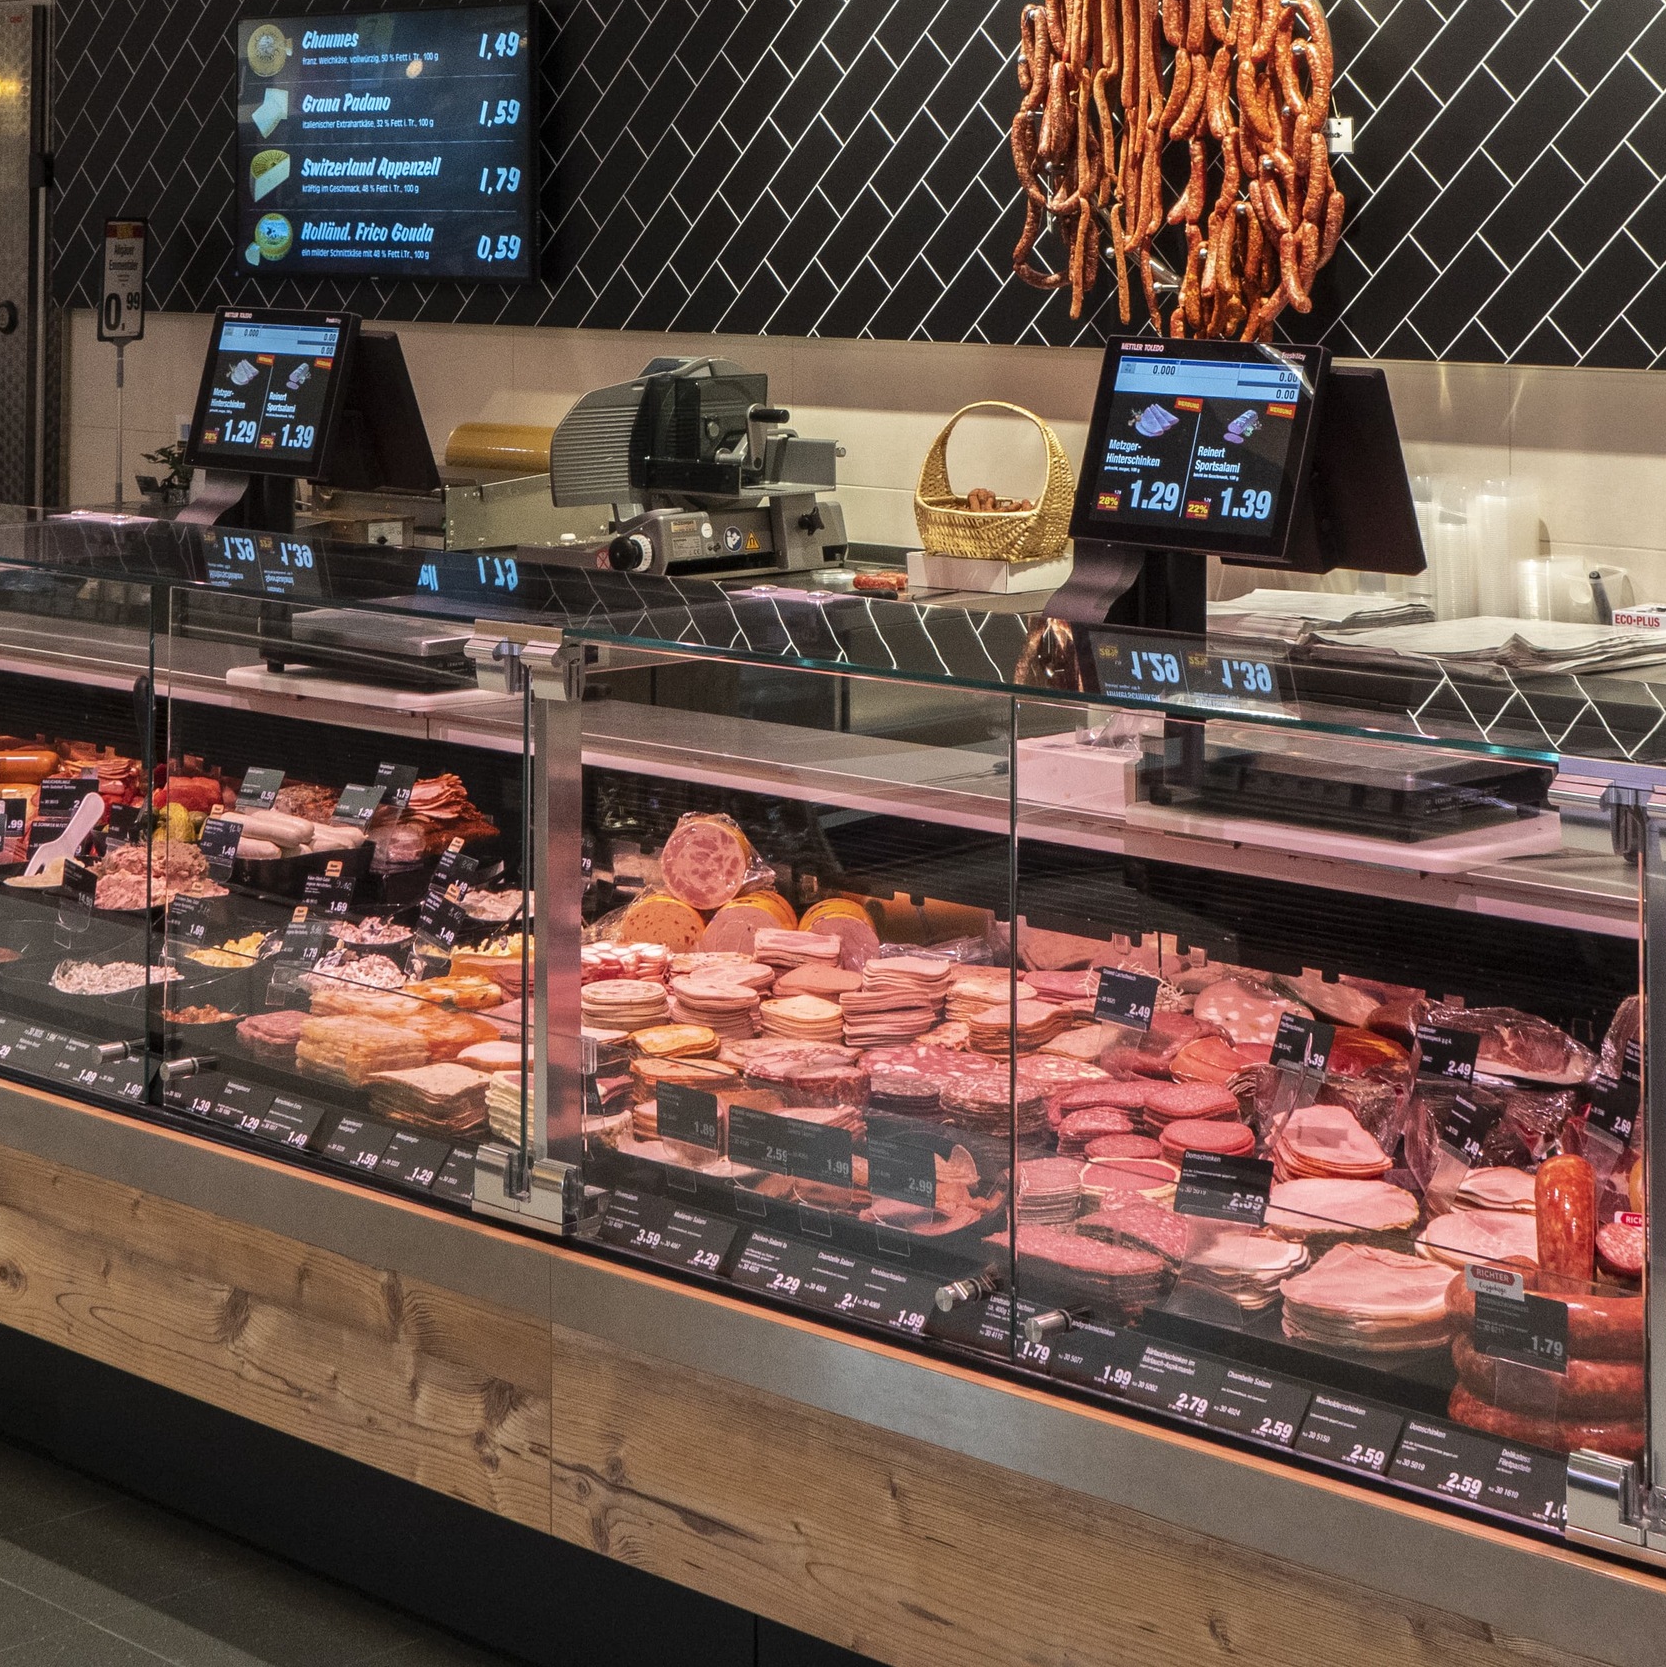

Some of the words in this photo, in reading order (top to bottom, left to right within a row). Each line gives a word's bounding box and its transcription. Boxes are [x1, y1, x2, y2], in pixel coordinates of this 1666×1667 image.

[302, 31, 358, 48] Chaumes
[479, 32, 519, 60] 1,49
[302, 94, 341, 113] Grana
[343, 93, 391, 111] Padano
[479, 100, 521, 127] 1,59
[391, 119, 403, 127] Fett
[419, 119, 428, 127] 100
[301, 158, 376, 177] Switzerland
[377, 157, 441, 179] Appenzell
[479, 167, 521, 195] 1,79
[301, 222, 351, 242] Holländ.
[355, 222, 388, 242] Frico
[392, 222, 434, 242] Gouda
[388, 250, 400, 258] Fett
[477, 235, 521, 262] 0,59
[321, 347, 333, 355] 0.00
[1121, 343, 1143, 351] METTLER
[1144, 344, 1164, 352] TOLEDO
[1153, 365, 1176, 376] 0.000
[1279, 373, 1298, 383] 0.00
[269, 392, 287, 401] Reinert
[1276, 389, 1295, 400] 0.00
[224, 419, 257, 443] 1.29
[281, 424, 315, 449] 1.39
[1109, 439, 1141, 452] Metzger-
[1198, 446, 1226, 458] Reinert
[1106, 453, 1160, 467] Hinterschinken
[1195, 460, 1241, 474] Sportsalami
[1098, 495, 1118, 506] 28%
[1131, 480, 1180, 511] 1.29
[1221, 487, 1271, 520] 1.39
[1187, 503, 1208, 514] 22%
[396, 788, 411, 799] 1.79
[357, 807, 374, 818] 1.29
[221, 846, 236, 857] 1.49
[329, 902, 348, 913] 1.69
[190, 923, 205, 936] 1.69
[302, 948, 318, 958] 1.79
[1129, 1003, 1150, 1019] 2.49
[1447, 1060, 1471, 1076] 2.49
[192, 1097, 211, 1113] 1.39
[240, 1114, 260, 1130] 1.29
[694, 1120, 715, 1137] 1.89
[1614, 1116, 1632, 1133] 2.69
[287, 1131, 307, 1146] 1.49
[1464, 1137, 1480, 1156] 2.49
[356, 1151, 378, 1167] 1.59
[1185, 1151, 1221, 1163] Domschinken
[411, 1166, 434, 1182] 1.29
[826, 1159, 849, 1175] 1.99
[909, 1177, 933, 1195] 2.99
[1229, 1192, 1264, 1211] 2.59
[1625, 1215, 1642, 1225] RICH
[636, 1229, 661, 1246] 3.59
[693, 1249, 720, 1267] 2.29
[773, 1273, 800, 1291] 2.29
[1476, 1268, 1509, 1281] RICHTER
[897, 1309, 925, 1328] 1.99
[1023, 1340, 1050, 1360] 1.79
[1531, 1335, 1564, 1357] 1.79
[1103, 1364, 1132, 1385] 1.99
[1176, 1393, 1208, 1413] 2.79
[1316, 1395, 1366, 1416] Wacholderschinken
[1259, 1417, 1293, 1439] 2.59
[1409, 1421, 1446, 1438] Domschinken
[1350, 1444, 1385, 1466] 2.59
[1446, 1472, 1482, 1495] 2.59
